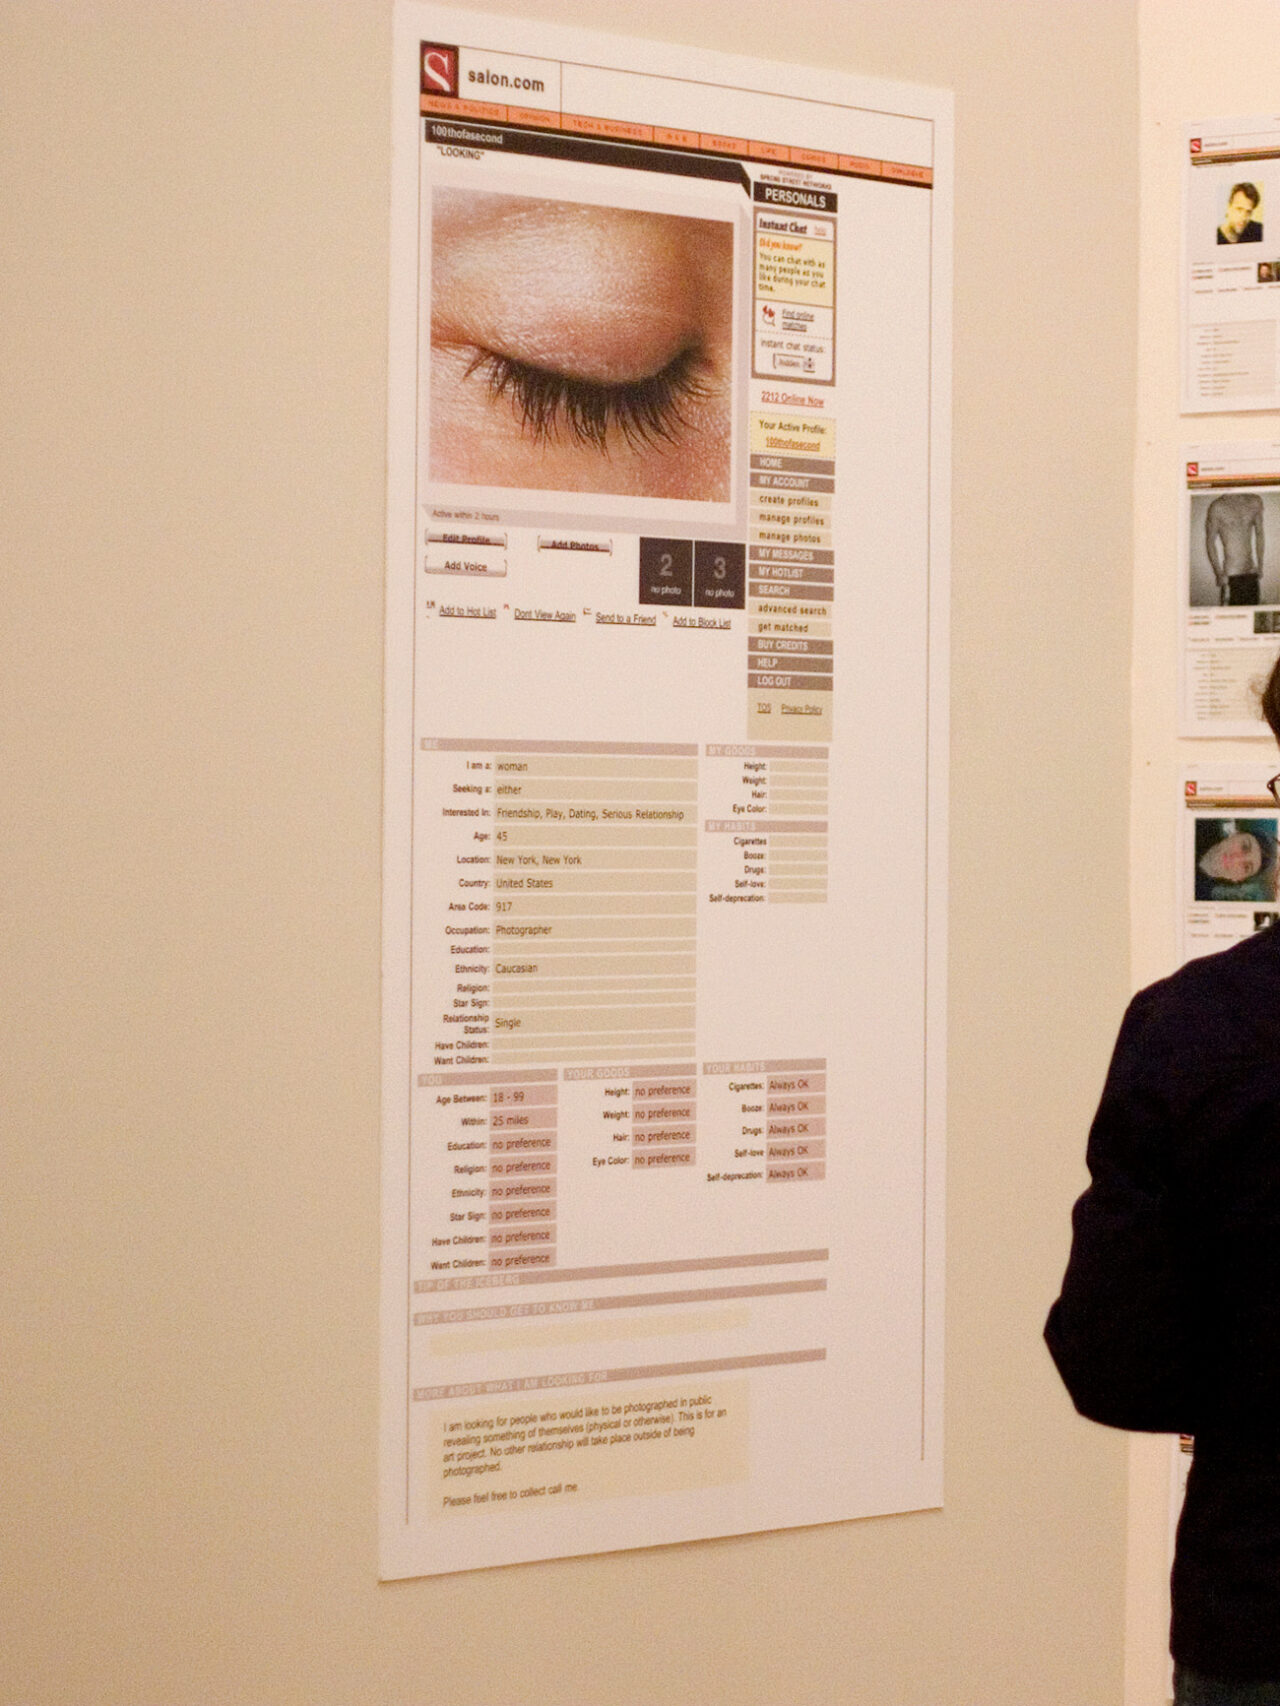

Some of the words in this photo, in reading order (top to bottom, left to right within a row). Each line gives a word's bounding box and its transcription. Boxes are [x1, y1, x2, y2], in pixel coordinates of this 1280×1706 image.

[468, 69, 544, 92] salon.com
[431, 125, 503, 144] 100thofasecond
[437, 146, 484, 161] "LOOKING"
[765, 187, 826, 209] PERSONALS
[759, 218, 788, 232] Instant
[789, 222, 808, 234] Chat
[762, 391, 779, 402] 2212
[782, 393, 805, 404] Online
[808, 396, 824, 407] Now
[759, 420, 775, 430] Your
[778, 422, 800, 432] Active
[760, 458, 782, 468] HOME
[760, 495, 784, 505] create
[788, 496, 819, 507] profiles
[760, 513, 790, 525] manage
[794, 514, 824, 526] profiles
[760, 532, 790, 543] manage
[794, 532, 821, 544] photos
[444, 560, 462, 571] Add
[464, 562, 488, 572] Voice
[660, 554, 673, 577] 2
[713, 556, 726, 579] 3
[661, 586, 682, 596] photo
[714, 588, 735, 598] photo
[758, 585, 790, 596] SEARCH
[439, 604, 454, 614] Add
[456, 606, 464, 615] to
[466, 606, 480, 616] Hot
[482, 607, 497, 617] List
[514, 608, 532, 618] Dont
[534, 610, 552, 619] View
[555, 610, 576, 622] Again
[758, 604, 797, 614] advanced
[800, 606, 826, 616] search
[596, 612, 614, 622] Send
[616, 614, 624, 623] to
[633, 613, 656, 624] Friend
[673, 617, 687, 626] Add
[689, 618, 696, 627] to
[698, 618, 716, 628] Block
[719, 619, 731, 628] List
[758, 622, 771, 632] get
[774, 622, 808, 632] matched
[758, 658, 778, 668] HELP
[757, 676, 774, 686] LOG
[776, 677, 792, 686] OUT
[497, 762, 528, 772] woman
[452, 784, 482, 795] Seeking
[496, 784, 522, 794] either
[442, 808, 479, 816] Interested
[497, 808, 542, 820] Friendship,
[546, 808, 566, 820] Play,
[569, 809, 598, 820] Dating,
[602, 810, 632, 819] Serious
[636, 810, 684, 821] Relationship
[473, 832, 490, 842] Age:
[496, 832, 508, 842] 45
[496, 855, 514, 864] New
[518, 855, 539, 866] York,
[542, 855, 560, 864] New
[563, 855, 582, 864] York
[496, 879, 524, 888] United
[526, 878, 554, 888] States
[448, 902, 466, 911] Area
[468, 902, 490, 911] Code:
[496, 902, 512, 912] 917
[445, 926, 490, 936] Occupation:
[496, 925, 552, 937] Photographer
[450, 945, 490, 954] Education:
[496, 963, 538, 974] Caucasian
[457, 984, 490, 994] Religion:
[453, 998, 469, 1008] Star
[443, 1014, 489, 1024] Relationship
[495, 1017, 522, 1030] Single
[434, 1042, 454, 1050] Have
[434, 1056, 454, 1065] Want
[605, 1087, 630, 1097] Height:
[636, 1088, 646, 1096] no
[648, 1086, 690, 1097] preference
[769, 1080, 796, 1091] Always
[798, 1080, 808, 1089] OK
[436, 1096, 452, 1106] Age
[493, 1092, 504, 1102] 18
[514, 1092, 524, 1102] 99
[462, 1117, 488, 1126] Within:
[493, 1116, 504, 1126] 25
[506, 1116, 528, 1125] miles
[506, 1138, 552, 1150] preference
[449, 1422, 462, 1432] am
[464, 1418, 494, 1432] looking
[496, 1416, 508, 1426] for
[510, 1413, 538, 1427] people
[540, 1412, 557, 1422] who
[560, 1408, 583, 1420] would
[586, 1407, 600, 1418] like
[602, 1406, 610, 1416] to
[612, 1404, 622, 1414] be
[624, 1398, 678, 1416] photographed
[680, 1397, 687, 1407] in
[689, 1394, 712, 1408] public
[444, 1434, 481, 1448] revealing
[483, 1428, 526, 1442] something
[528, 1427, 536, 1438] of
[538, 1422, 584, 1437] themselves
[586, 1418, 621, 1433] (physical
[623, 1418, 632, 1428] or
[678, 1410, 694, 1422] This
[696, 1409, 702, 1420] is
[704, 1408, 714, 1418] for
[717, 1408, 727, 1418] an
[444, 1452, 454, 1462] art
[490, 1446, 502, 1456] No
[504, 1444, 526, 1456] other
[528, 1438, 574, 1453] relationship
[576, 1436, 589, 1447] will
[591, 1434, 608, 1446] take
[610, 1432, 632, 1446] place
[634, 1428, 662, 1441] outside
[664, 1426, 672, 1438] of
[674, 1426, 695, 1438] being
[443, 1494, 472, 1507] Please
[473, 1492, 489, 1504] feel
[491, 1490, 507, 1500] free
[510, 1489, 518, 1499] to
[520, 1485, 546, 1498] collect
[548, 1482, 562, 1494] call
[564, 1483, 578, 1492] me
